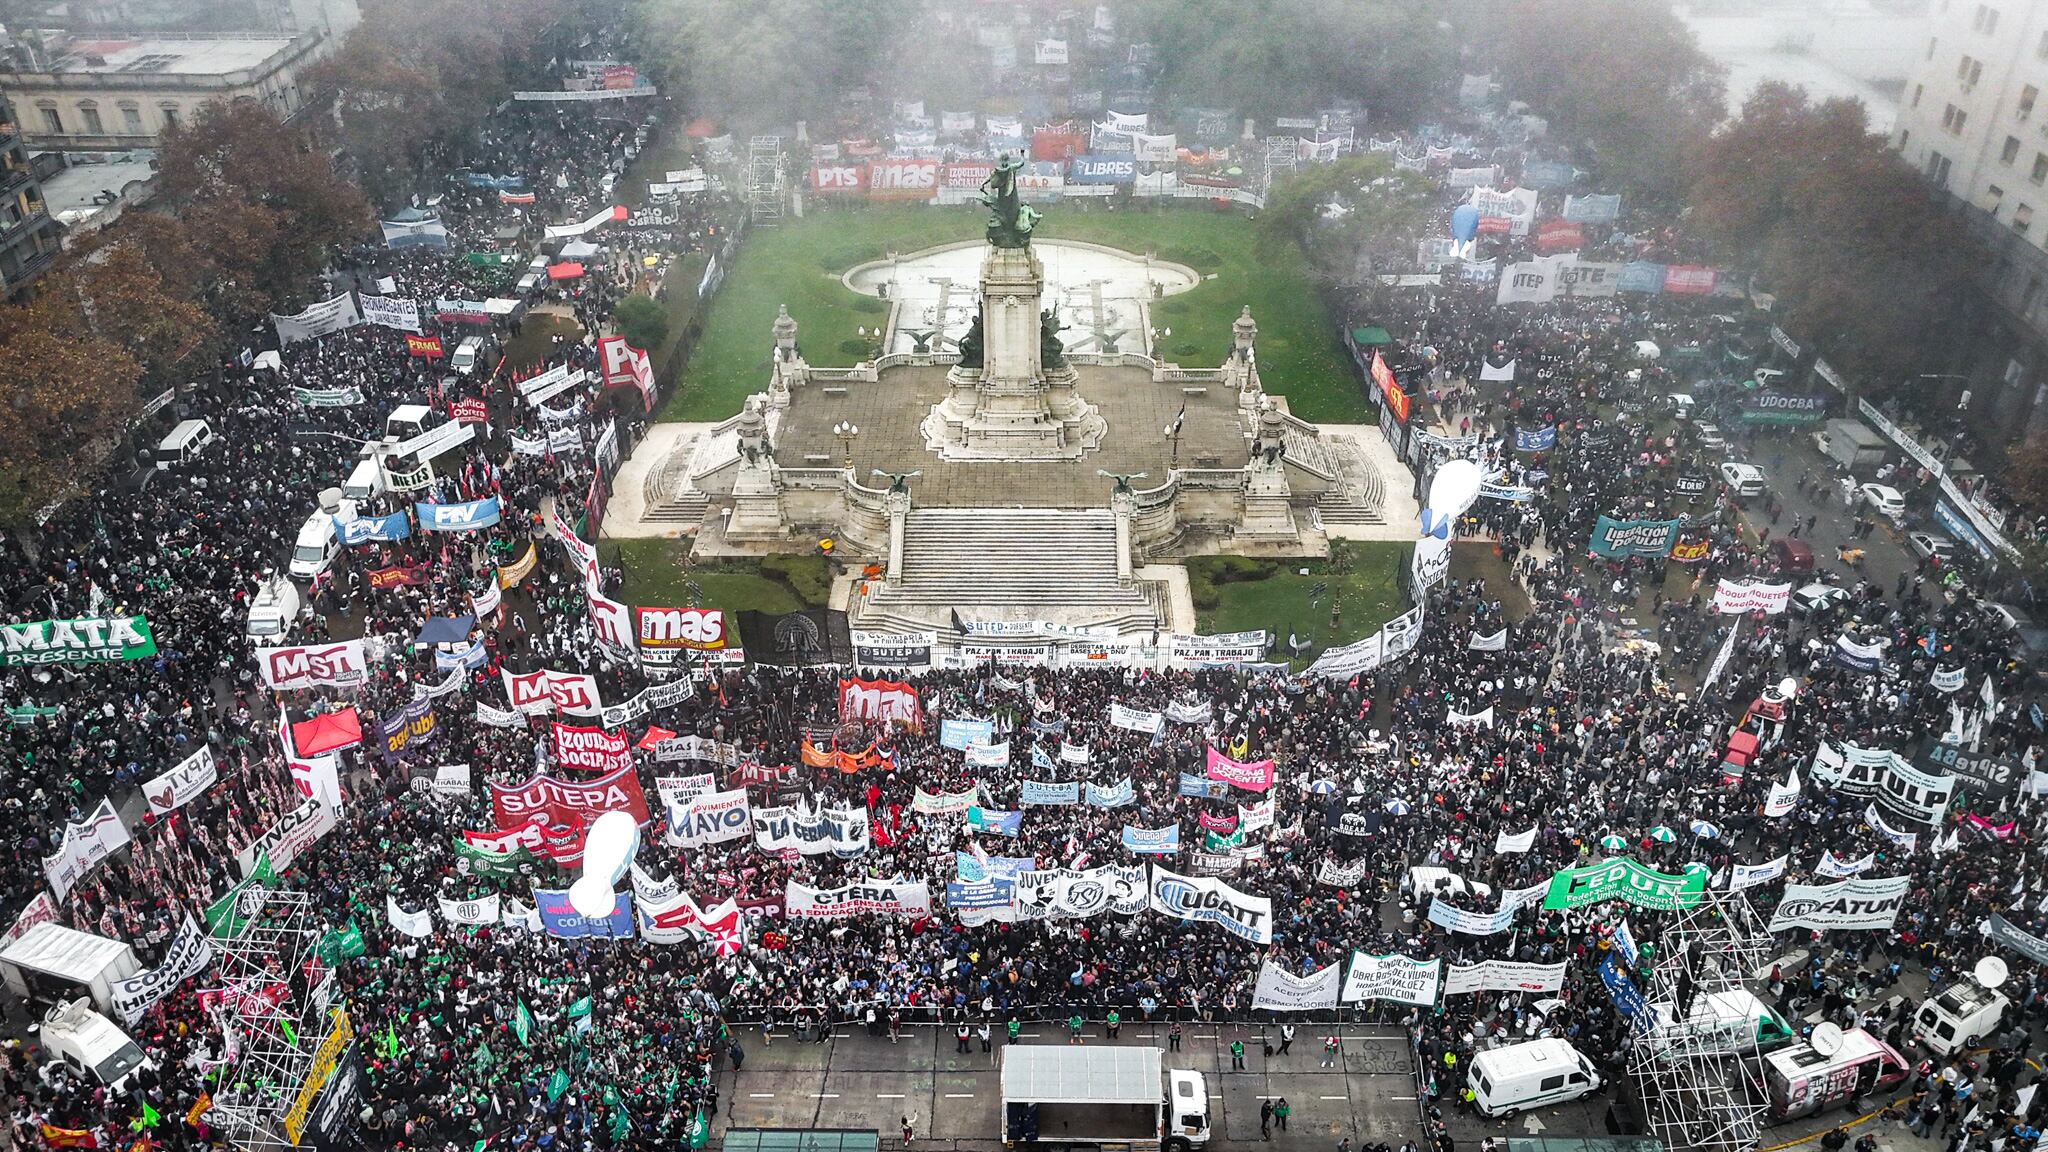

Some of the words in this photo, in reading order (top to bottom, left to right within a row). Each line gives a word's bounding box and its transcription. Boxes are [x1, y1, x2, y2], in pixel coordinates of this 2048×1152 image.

[1116, 122, 1146, 132] LIBRES
[818, 166, 858, 187] PTS
[881, 164, 936, 189] mas
[1084, 161, 1134, 176] LIBRES
[627, 214, 673, 227] OBRERO
[633, 206, 662, 219] POLO
[1512, 272, 1544, 289] UTEP
[408, 339, 440, 351] PRML
[1759, 396, 1815, 410] UDOCBA
[453, 408, 486, 418] Obrera
[1603, 525, 1669, 541] LIBERACIÓN
[1610, 535, 1666, 551] POPULAR
[1725, 599, 1775, 609] NACIONAL
[0, 618, 146, 652] MATA
[650, 610, 723, 643] mas
[7, 648, 124, 665] PRESENTE
[872, 647, 912, 657] SUTEP
[1215, 648, 1254, 657] TRABAJO
[274, 651, 352, 680] MST
[518, 676, 590, 706] MST
[627, 699, 637, 710] LA
[630, 707, 645, 719] DEL
[742, 764, 787, 783] MTL
[1212, 767, 1267, 784] DOCENTE
[1215, 760, 1265, 777] TRIBUNA
[413, 779, 431, 791] ATE
[1029, 783, 1072, 791] SUTEBA
[1092, 783, 1128, 797] SUTEBA
[1847, 764, 1948, 808] ATULP
[500, 782, 628, 814] SUTEPA
[674, 790, 703, 799] SUTEBA
[691, 797, 746, 815] MOVIMIENTO
[666, 805, 747, 838] MAYO
[769, 817, 790, 842] LA
[252, 799, 322, 862] ANCLA
[793, 819, 844, 842] GERMAN
[1191, 856, 1202, 866] LA
[718, 873, 735, 882] CICOP
[1019, 868, 1085, 889] JUVENTUD
[1095, 864, 1146, 884] SINDICAL
[1569, 865, 1682, 898] FEDUN
[815, 887, 898, 904] CTERA
[459, 904, 480, 918] ATE
[788, 908, 803, 916] LA
[831, 901, 882, 910] DEFENSA
[1018, 898, 1046, 917] TODOS
[1182, 889, 1266, 928] UGATT
[1816, 895, 1901, 915] FATUN
[1193, 909, 1263, 942] PRESENTE
[123, 920, 192, 994] CONADU
[121, 932, 204, 1012] HISTORICA
[1257, 996, 1336, 1009] DESMOTADORES
